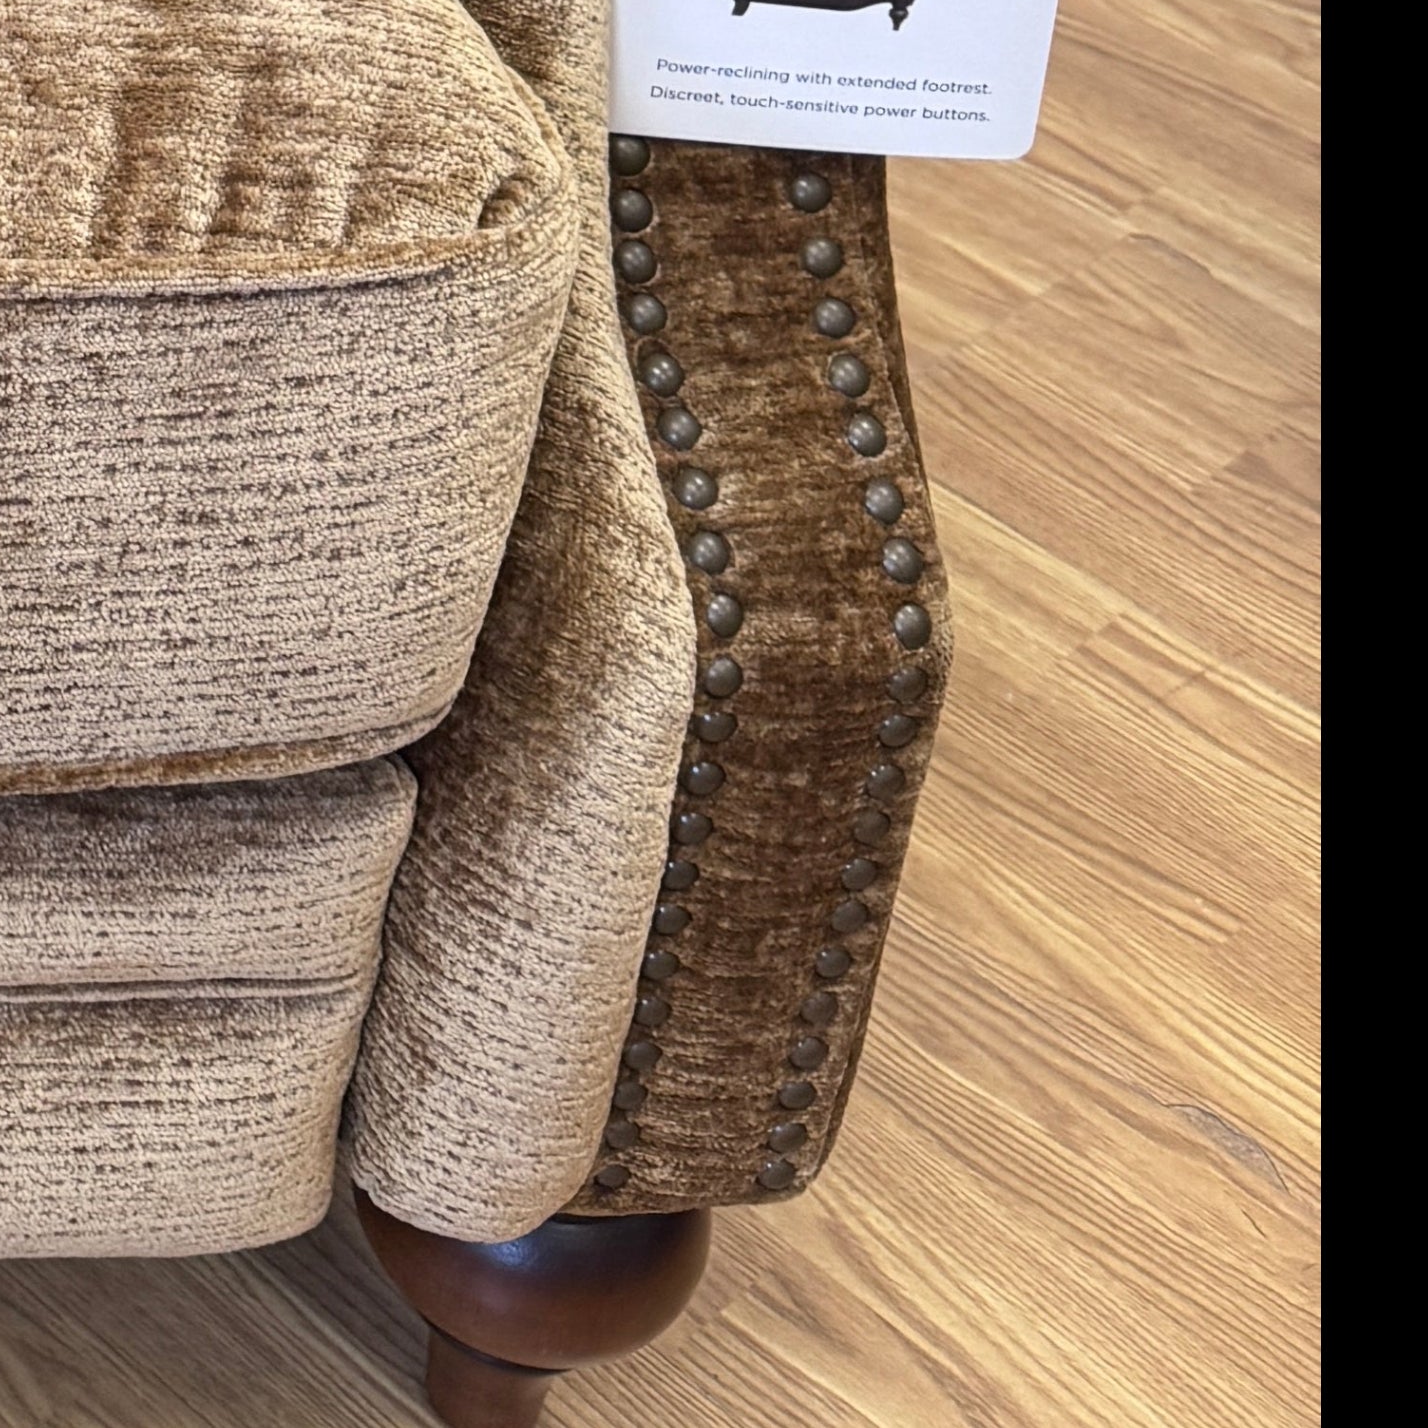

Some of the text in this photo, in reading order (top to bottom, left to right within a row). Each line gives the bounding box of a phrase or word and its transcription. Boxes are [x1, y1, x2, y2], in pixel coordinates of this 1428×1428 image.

[656, 57, 992, 95] Power-reclining with extended footrest.
[649, 85, 991, 123] Discreet, touch-sensitive power buttons.
